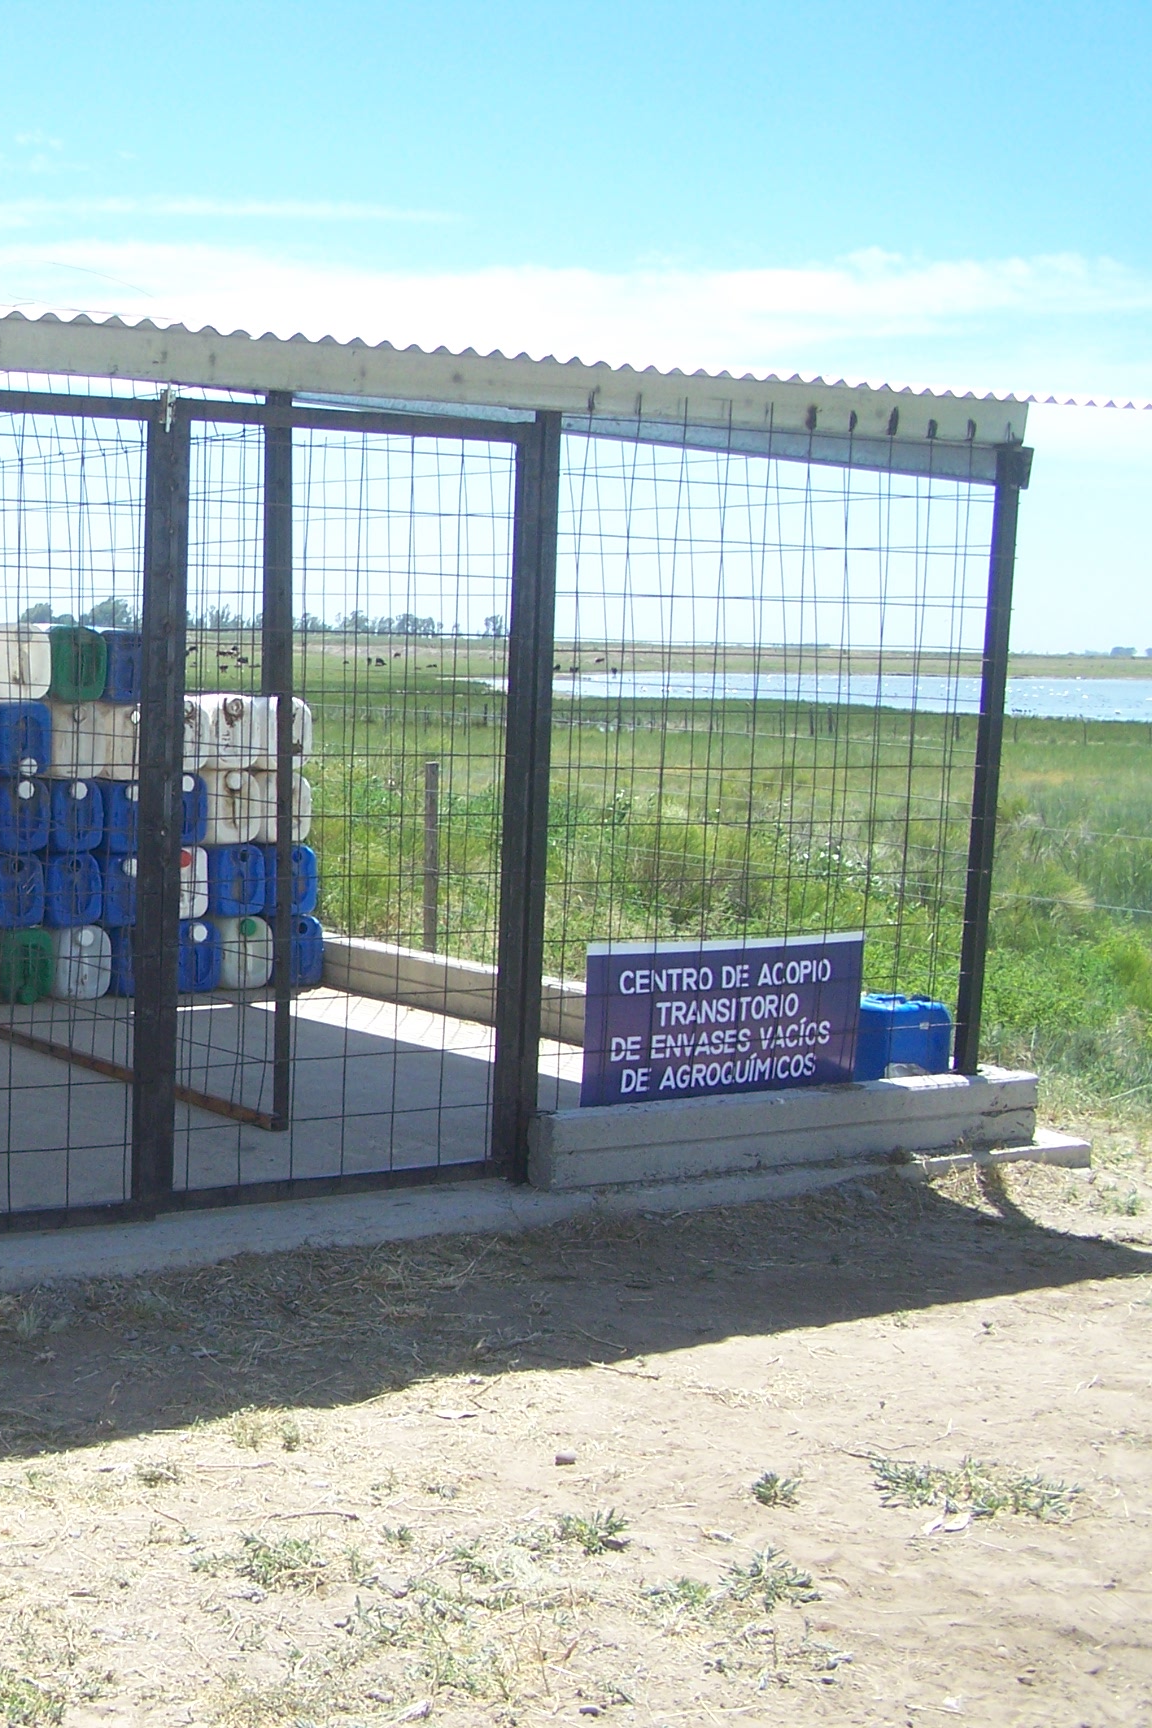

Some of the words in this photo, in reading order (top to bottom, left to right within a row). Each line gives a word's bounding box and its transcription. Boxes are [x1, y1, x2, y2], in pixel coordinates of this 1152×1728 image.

[619, 967, 713, 994] CENTRO
[721, 965, 750, 989] DE
[758, 959, 832, 987] ACOPIO
[656, 993, 799, 1027] TRANSITORIO
[610, 1036, 642, 1062] DE
[650, 1028, 751, 1060] ENVASES
[759, 1017, 831, 1050] VACÍOS
[620, 1068, 651, 1093] DE
[659, 1053, 817, 1091] AGROQUÍMICOS
